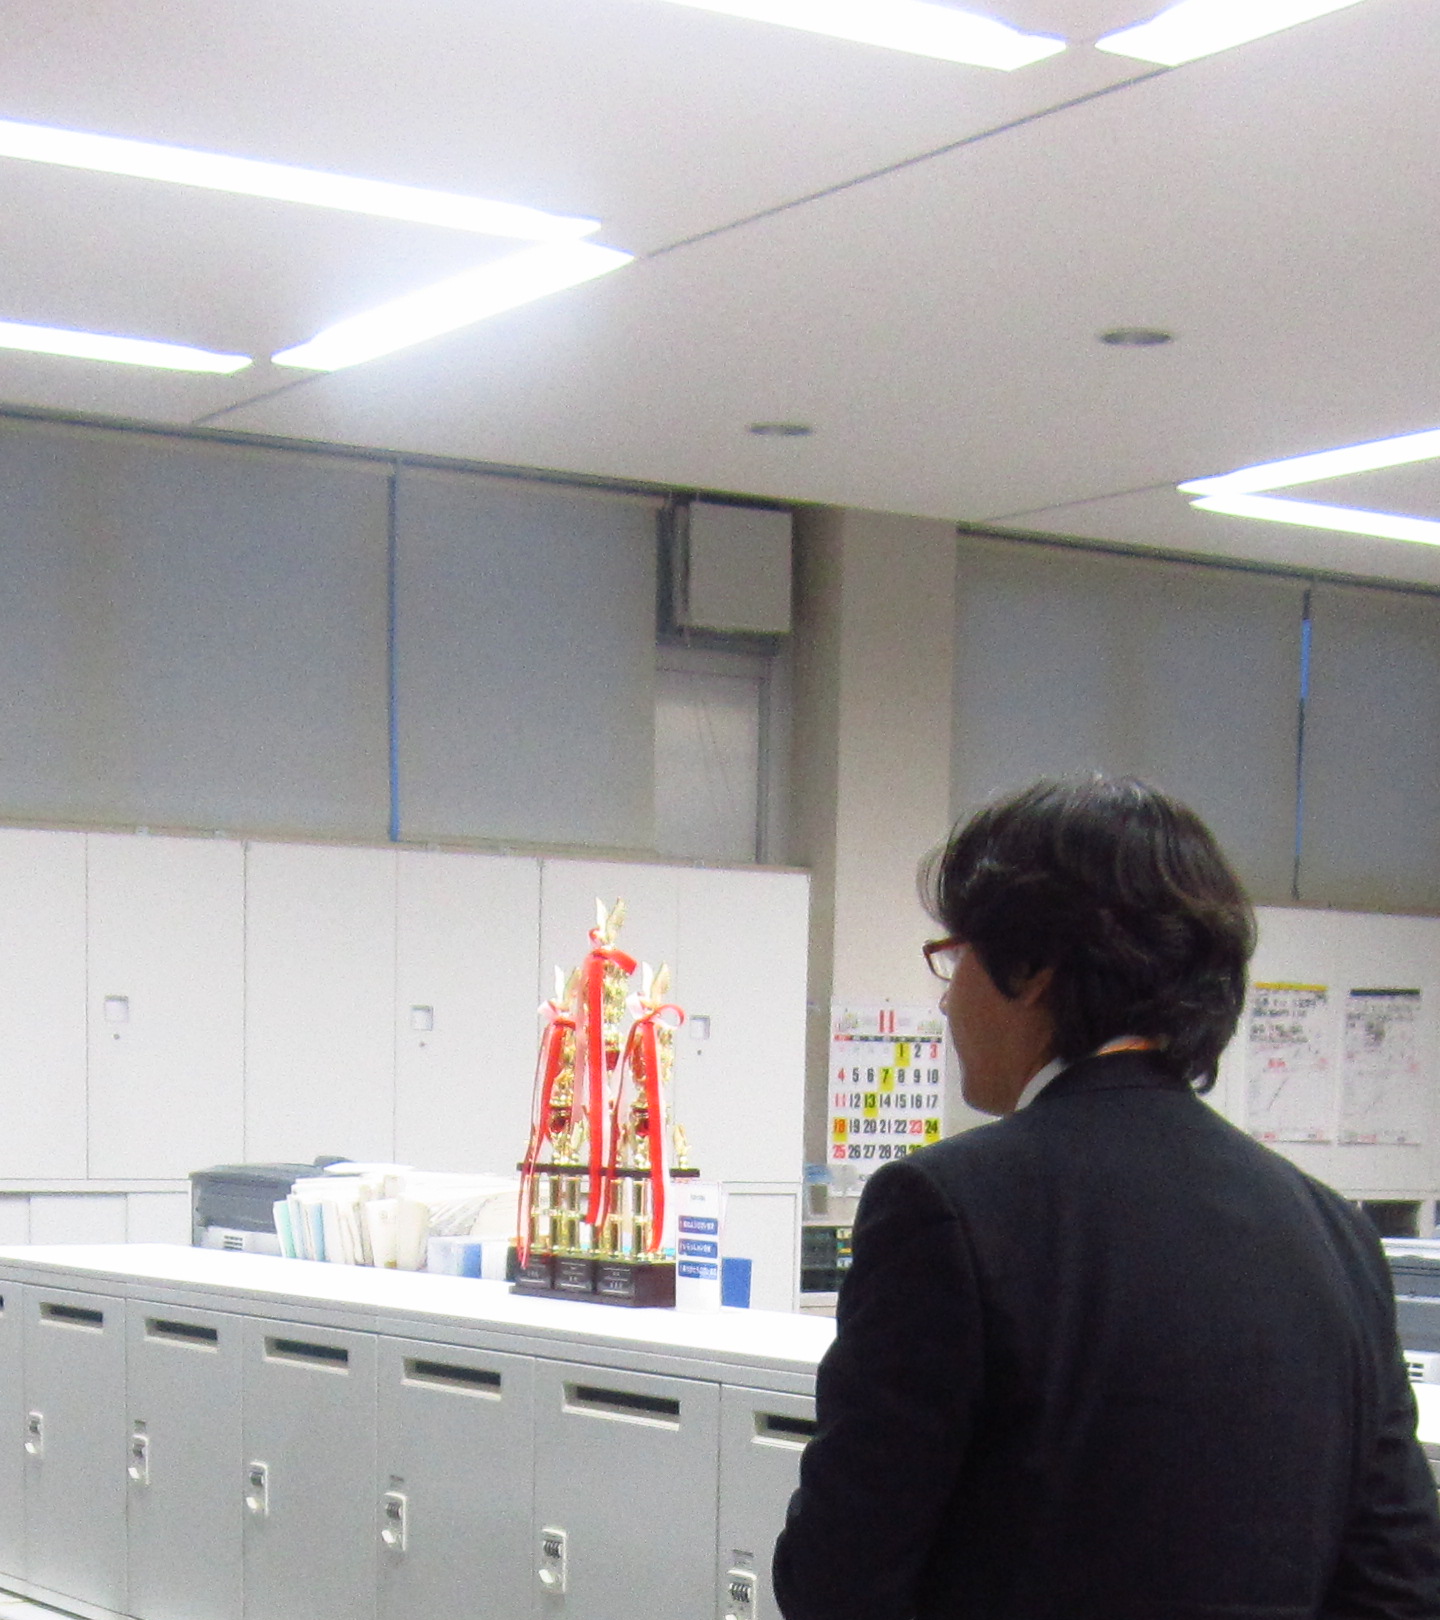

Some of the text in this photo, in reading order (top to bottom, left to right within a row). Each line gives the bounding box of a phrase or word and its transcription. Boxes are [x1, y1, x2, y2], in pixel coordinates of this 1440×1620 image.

[879, 1010, 895, 1033] 11
[899, 1043, 937, 1058] 1 2 3
[838, 1068, 939, 1083] 4 5 6 7 8 9 10
[835, 1093, 938, 1109] 11 12 13 14 15 16 17
[834, 1119, 938, 1134] 18 19 20 21 22 23 24
[833, 1145, 846, 1159] 25
[848, 1145, 861, 1159] 26
[863, 1145, 876, 1159] 27
[878, 1145, 891, 1159] 28
